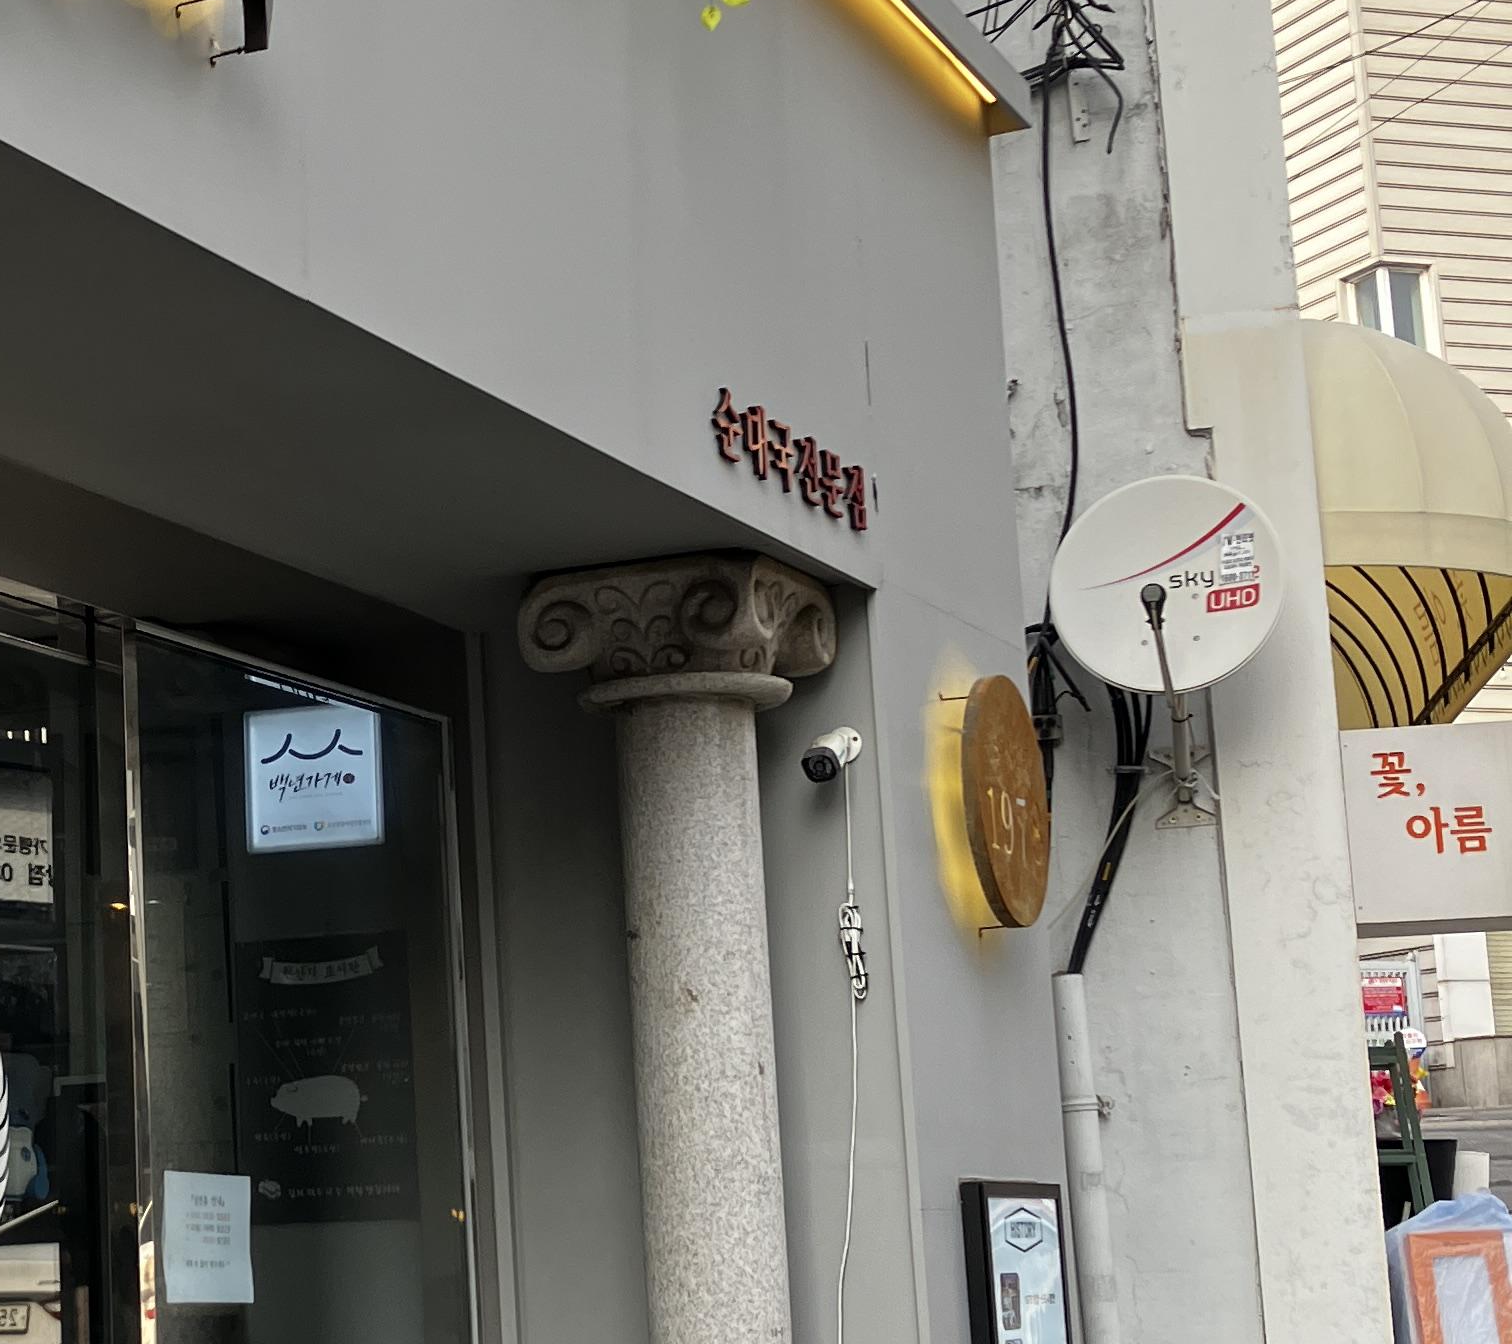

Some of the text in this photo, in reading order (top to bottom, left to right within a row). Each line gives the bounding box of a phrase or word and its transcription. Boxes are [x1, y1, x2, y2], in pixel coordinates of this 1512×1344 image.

[711, 387, 867, 531] 순대국전문점
[1169, 570, 1214, 589] sky
[1210, 587, 1256, 609] UHD
[269, 770, 343, 803] 백년가게
[1370, 751, 1426, 799] 꽃,
[1406, 806, 1492, 855] 아름
